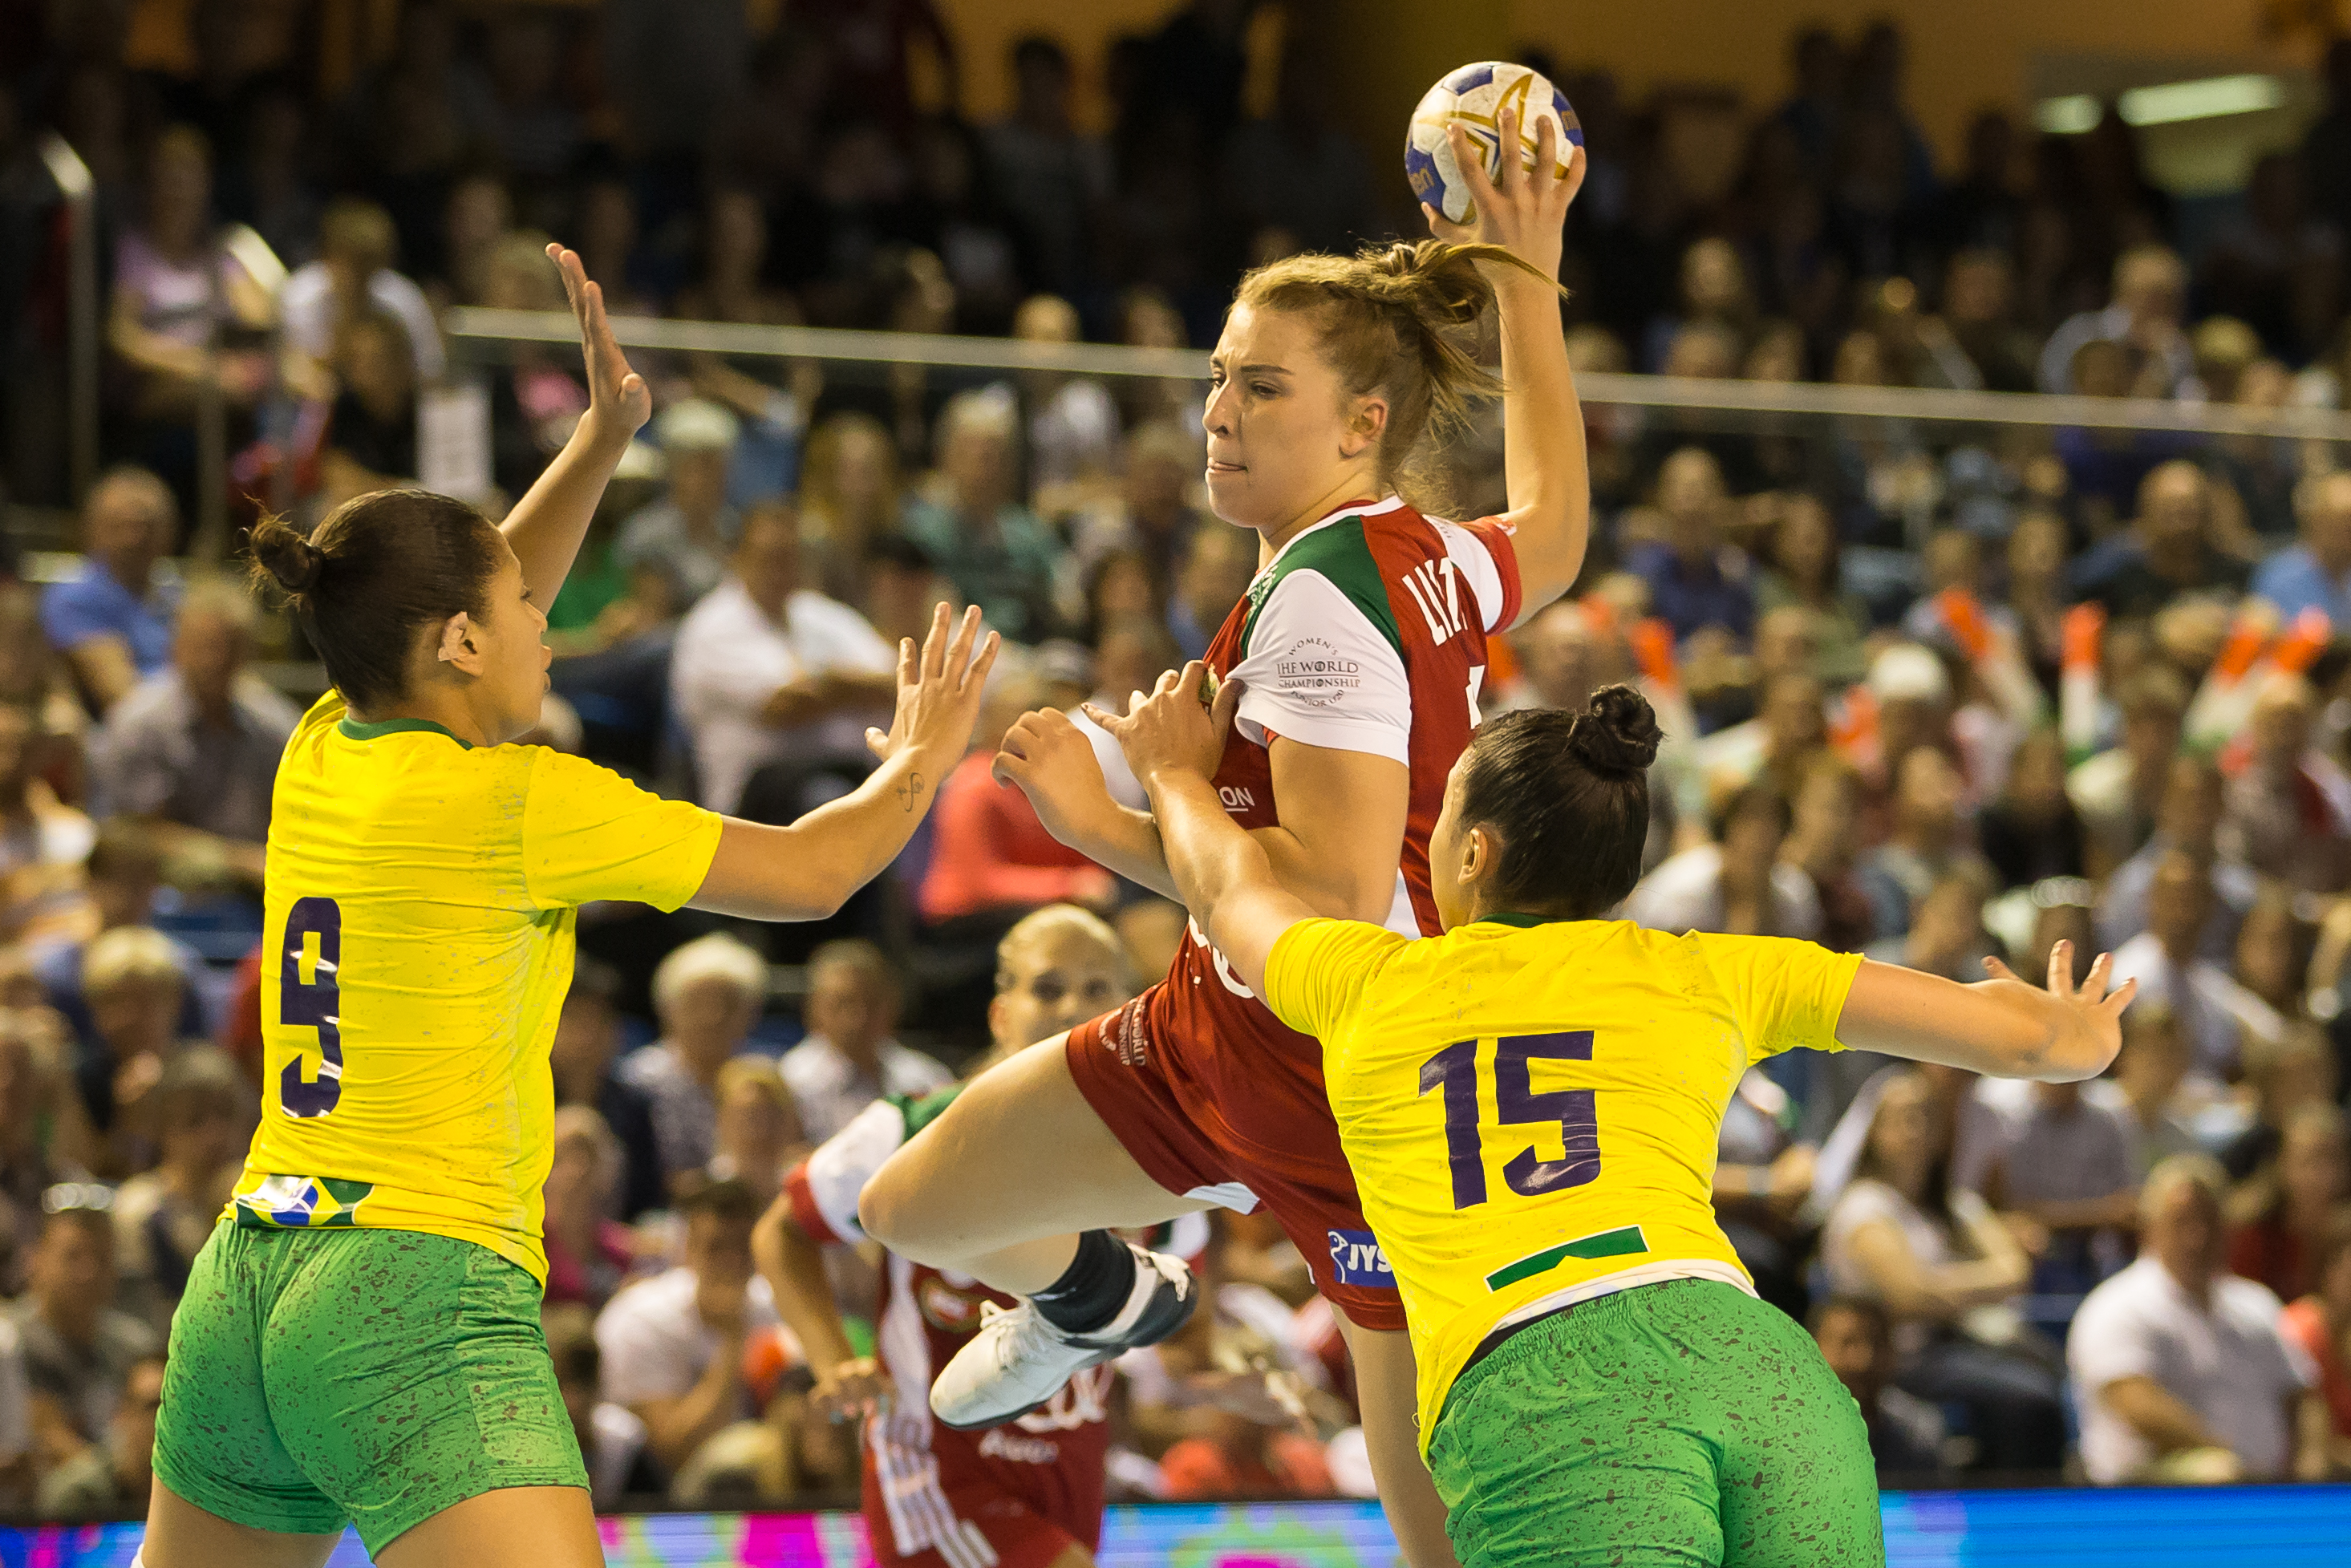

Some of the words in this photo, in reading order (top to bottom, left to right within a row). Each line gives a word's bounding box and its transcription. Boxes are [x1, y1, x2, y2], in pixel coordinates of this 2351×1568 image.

[1288, 637, 1338, 656] WOMEN'S
[1277, 662, 1297, 675] IHF
[1299, 660, 1359, 674] WORLD
[1278, 678, 1361, 688] CHAMPIONSHIP
[280, 896, 344, 1119] 9
[1417, 1030, 1602, 1211] 15
